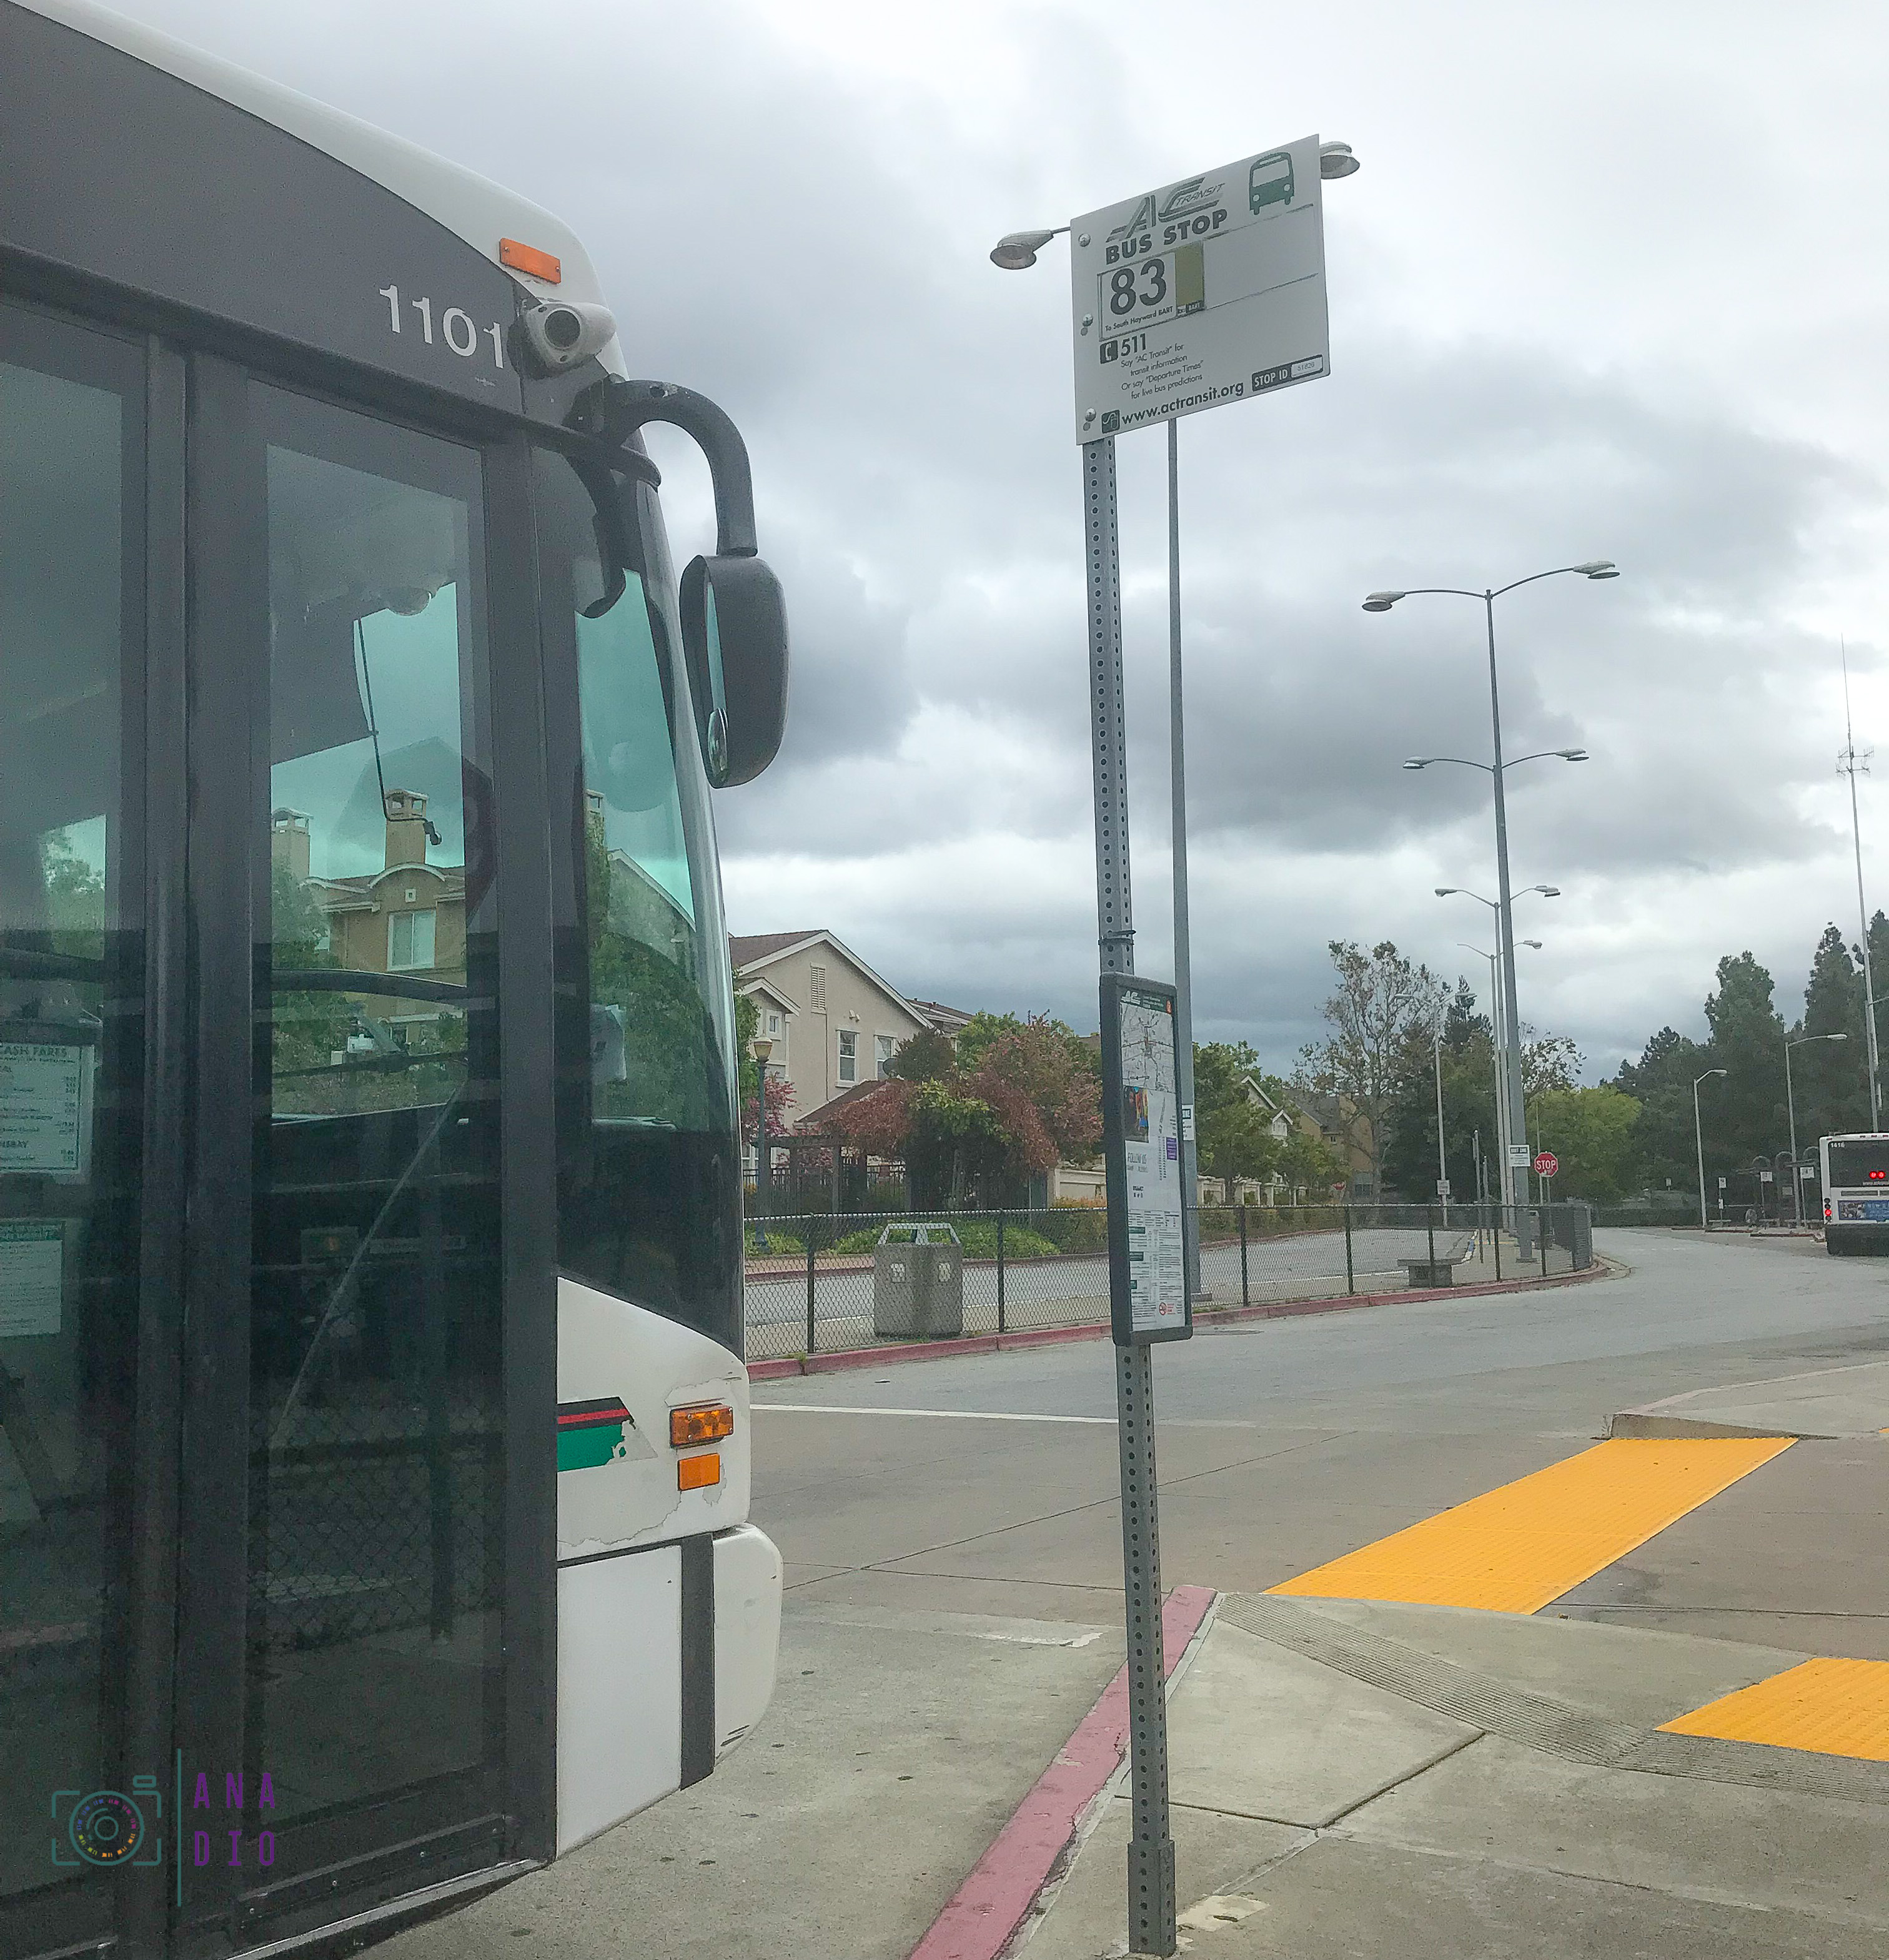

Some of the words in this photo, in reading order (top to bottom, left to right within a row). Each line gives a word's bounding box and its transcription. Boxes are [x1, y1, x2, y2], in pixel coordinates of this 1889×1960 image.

[1106, 177, 1220, 242] AC
[1176, 182, 1226, 207] TRANSIT
[1106, 234, 1153, 265] BUS
[1163, 209, 1227, 245] STOP
[1110, 259, 1167, 315] 83
[379, 284, 503, 369] 1101
[1113, 319, 1129, 329] South
[1130, 309, 1157, 324] Hayward
[1158, 306, 1173, 316] BART
[1121, 333, 1146, 357] 511
[1121, 360, 1133, 368] Say
[1174, 344, 1185, 352] for
[1130, 365, 1149, 376] transit
[1151, 355, 1187, 370] information
[1121, 382, 1131, 390] Or
[1133, 380, 1144, 389] say
[1131, 390, 1140, 399] for
[1142, 388, 1153, 396] live
[1154, 384, 1166, 393] bus
[1168, 374, 1203, 391] predictions
[1254, 372, 1276, 387] STOP
[1279, 369, 1288, 380] ID
[1122, 382, 1244, 425] www.actransit.org
[1536, 1160, 1556, 1170] STOP
